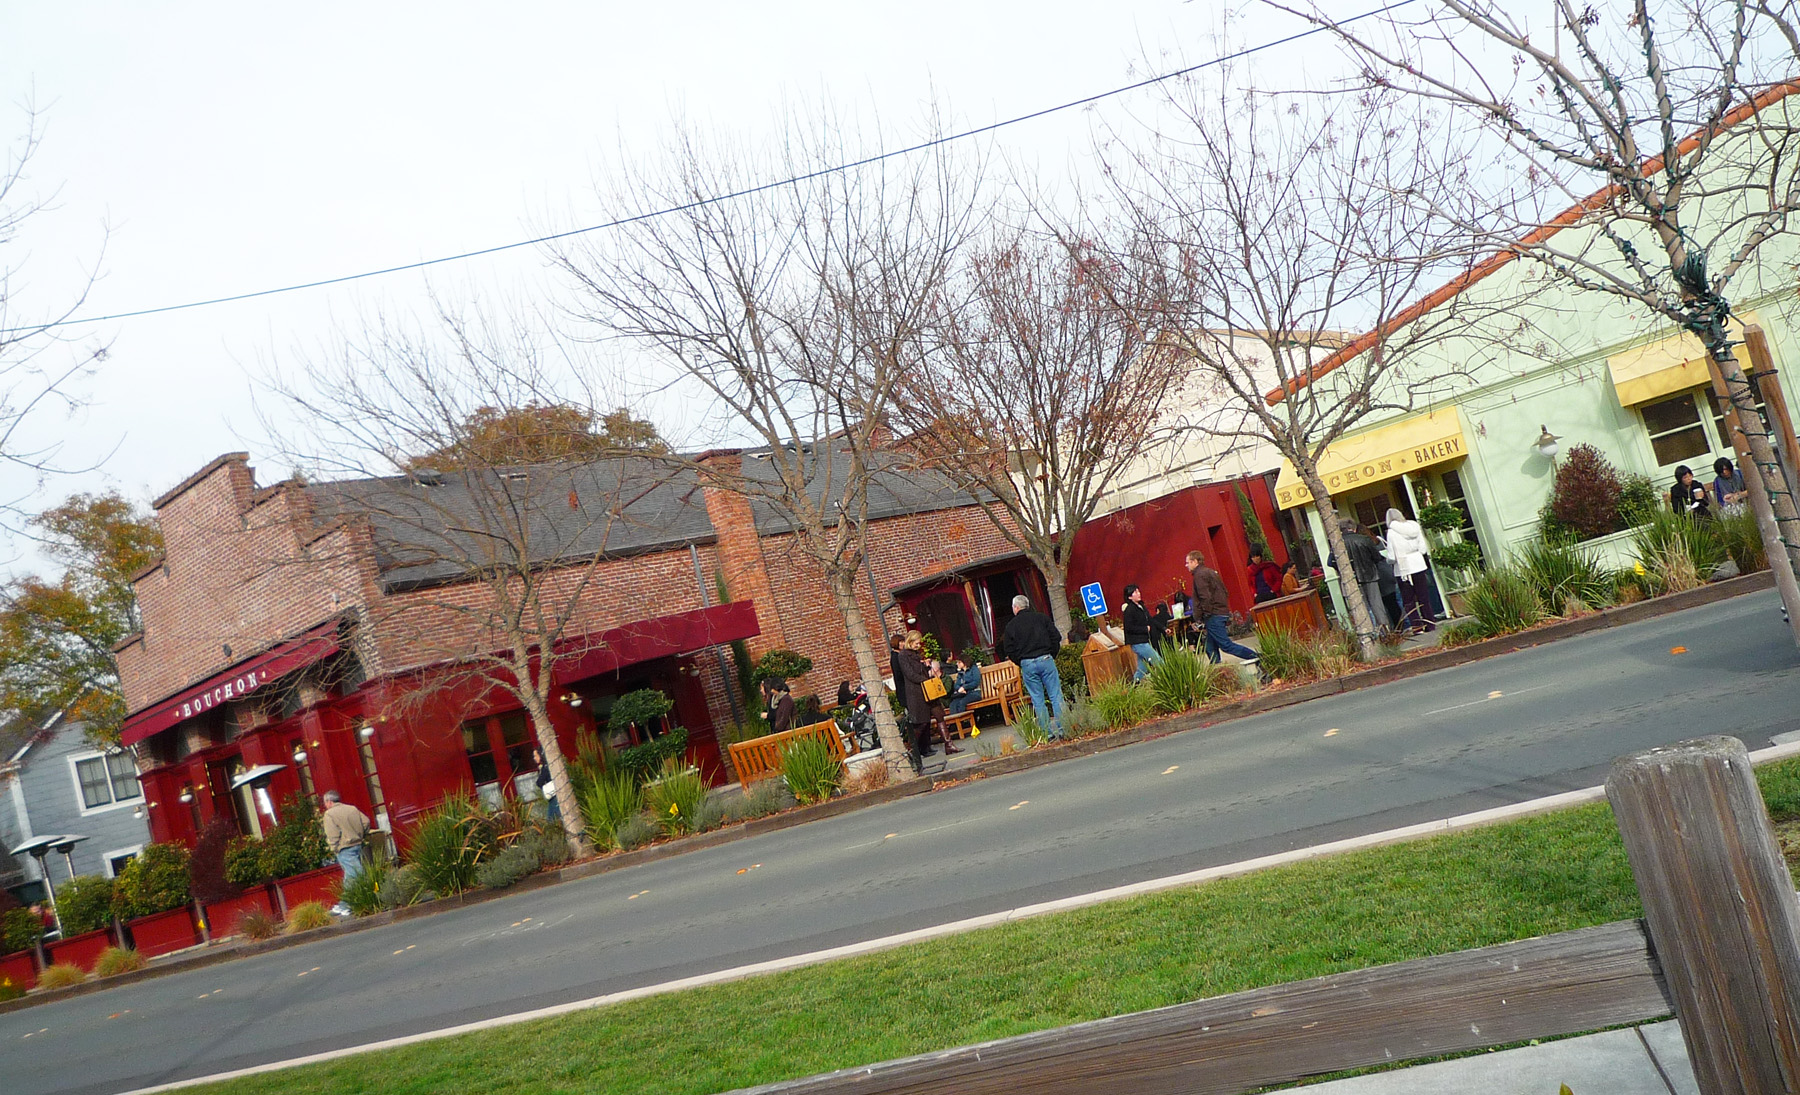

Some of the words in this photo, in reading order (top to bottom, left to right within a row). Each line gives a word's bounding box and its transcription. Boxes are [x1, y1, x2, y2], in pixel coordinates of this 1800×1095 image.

[1279, 460, 1393, 504] BOCHON
[1414, 438, 1460, 464] BAKERY
[183, 672, 258, 717] BOUCHON
